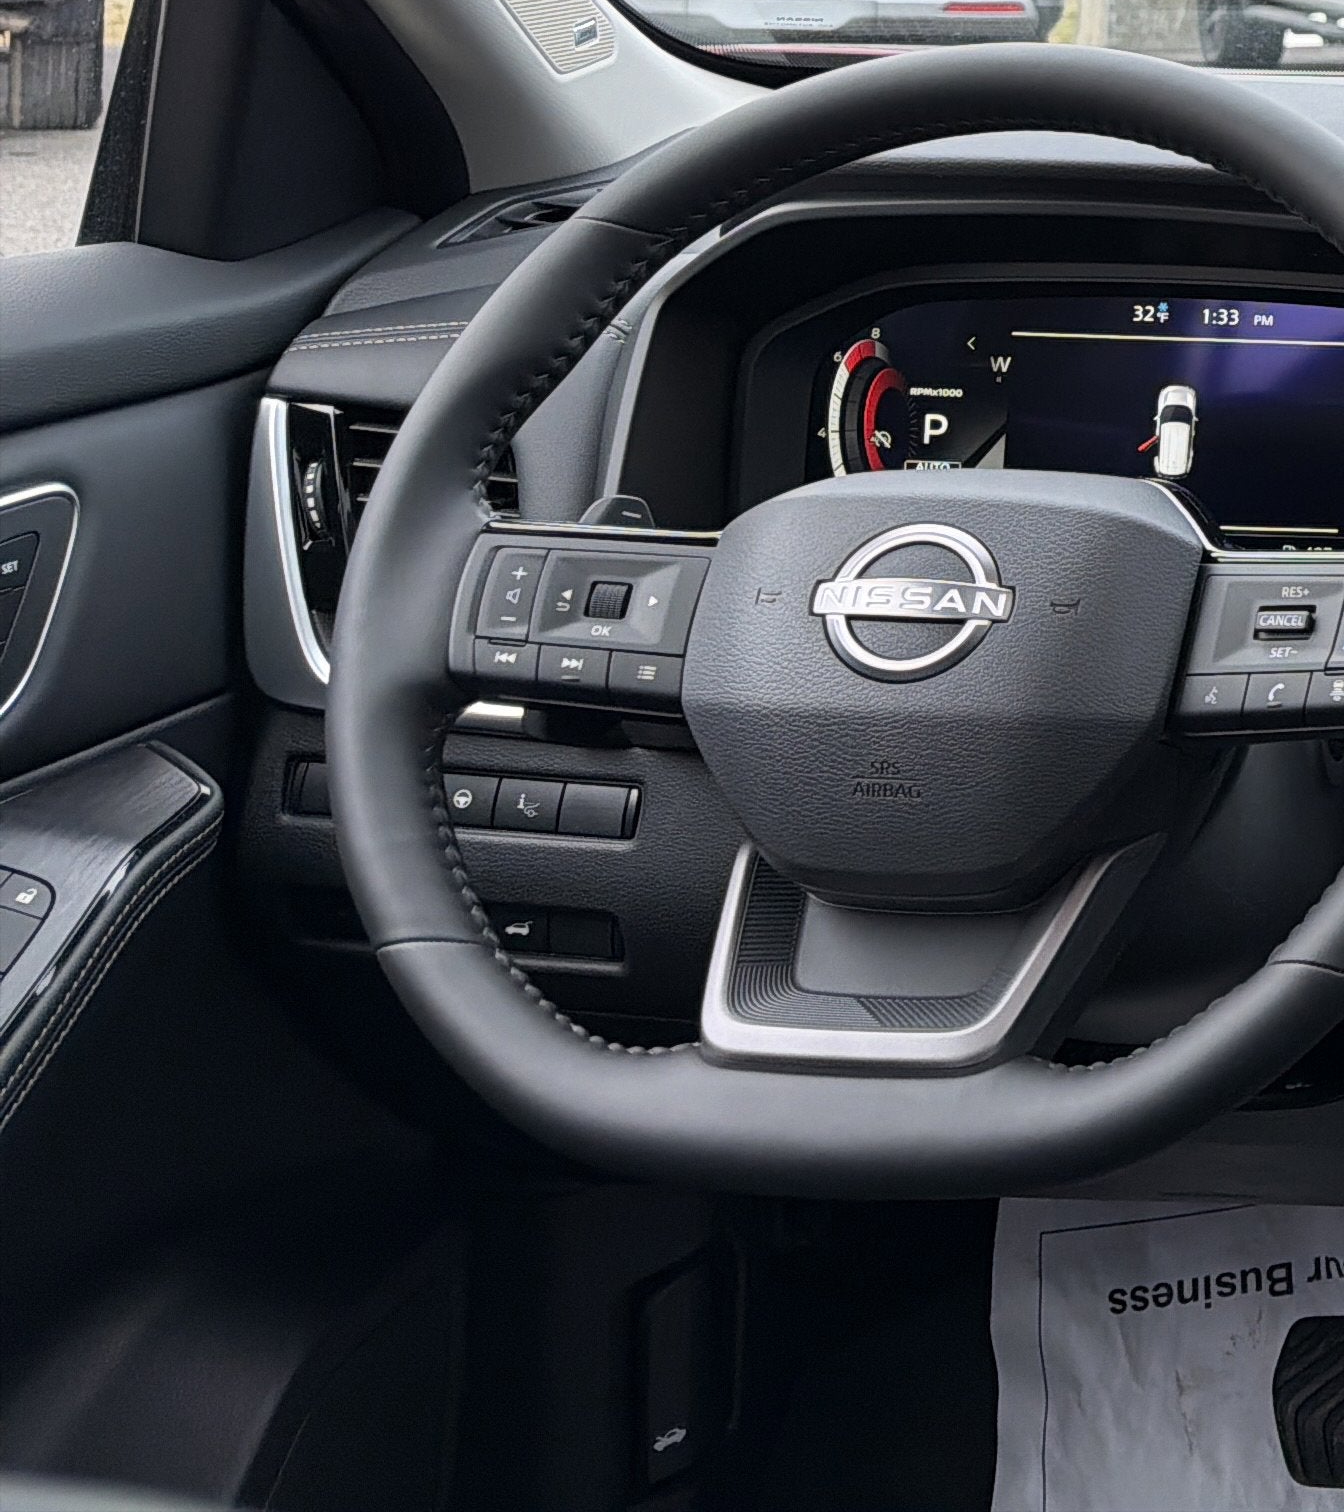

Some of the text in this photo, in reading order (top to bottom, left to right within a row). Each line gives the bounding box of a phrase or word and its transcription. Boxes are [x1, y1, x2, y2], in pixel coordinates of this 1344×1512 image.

[1132, 305, 1155, 323] 32
[1201, 308, 1275, 327] 1:33 PM
[870, 327, 882, 339] 8
[832, 350, 843, 363] 6
[989, 355, 1013, 374] W
[908, 386, 965, 399] RPMx1000
[816, 427, 827, 439] 4
[922, 412, 950, 446] P
[0, 559, 19, 575] SET
[1280, 585, 1311, 599] RES+
[820, 585, 1007, 618] NISSAN
[1257, 614, 1305, 628] CANCEL
[589, 624, 612, 637] OK
[869, 760, 901, 775] SRS
[851, 780, 921, 799] AIRBAG
[1108, 1262, 1294, 1315] Business
